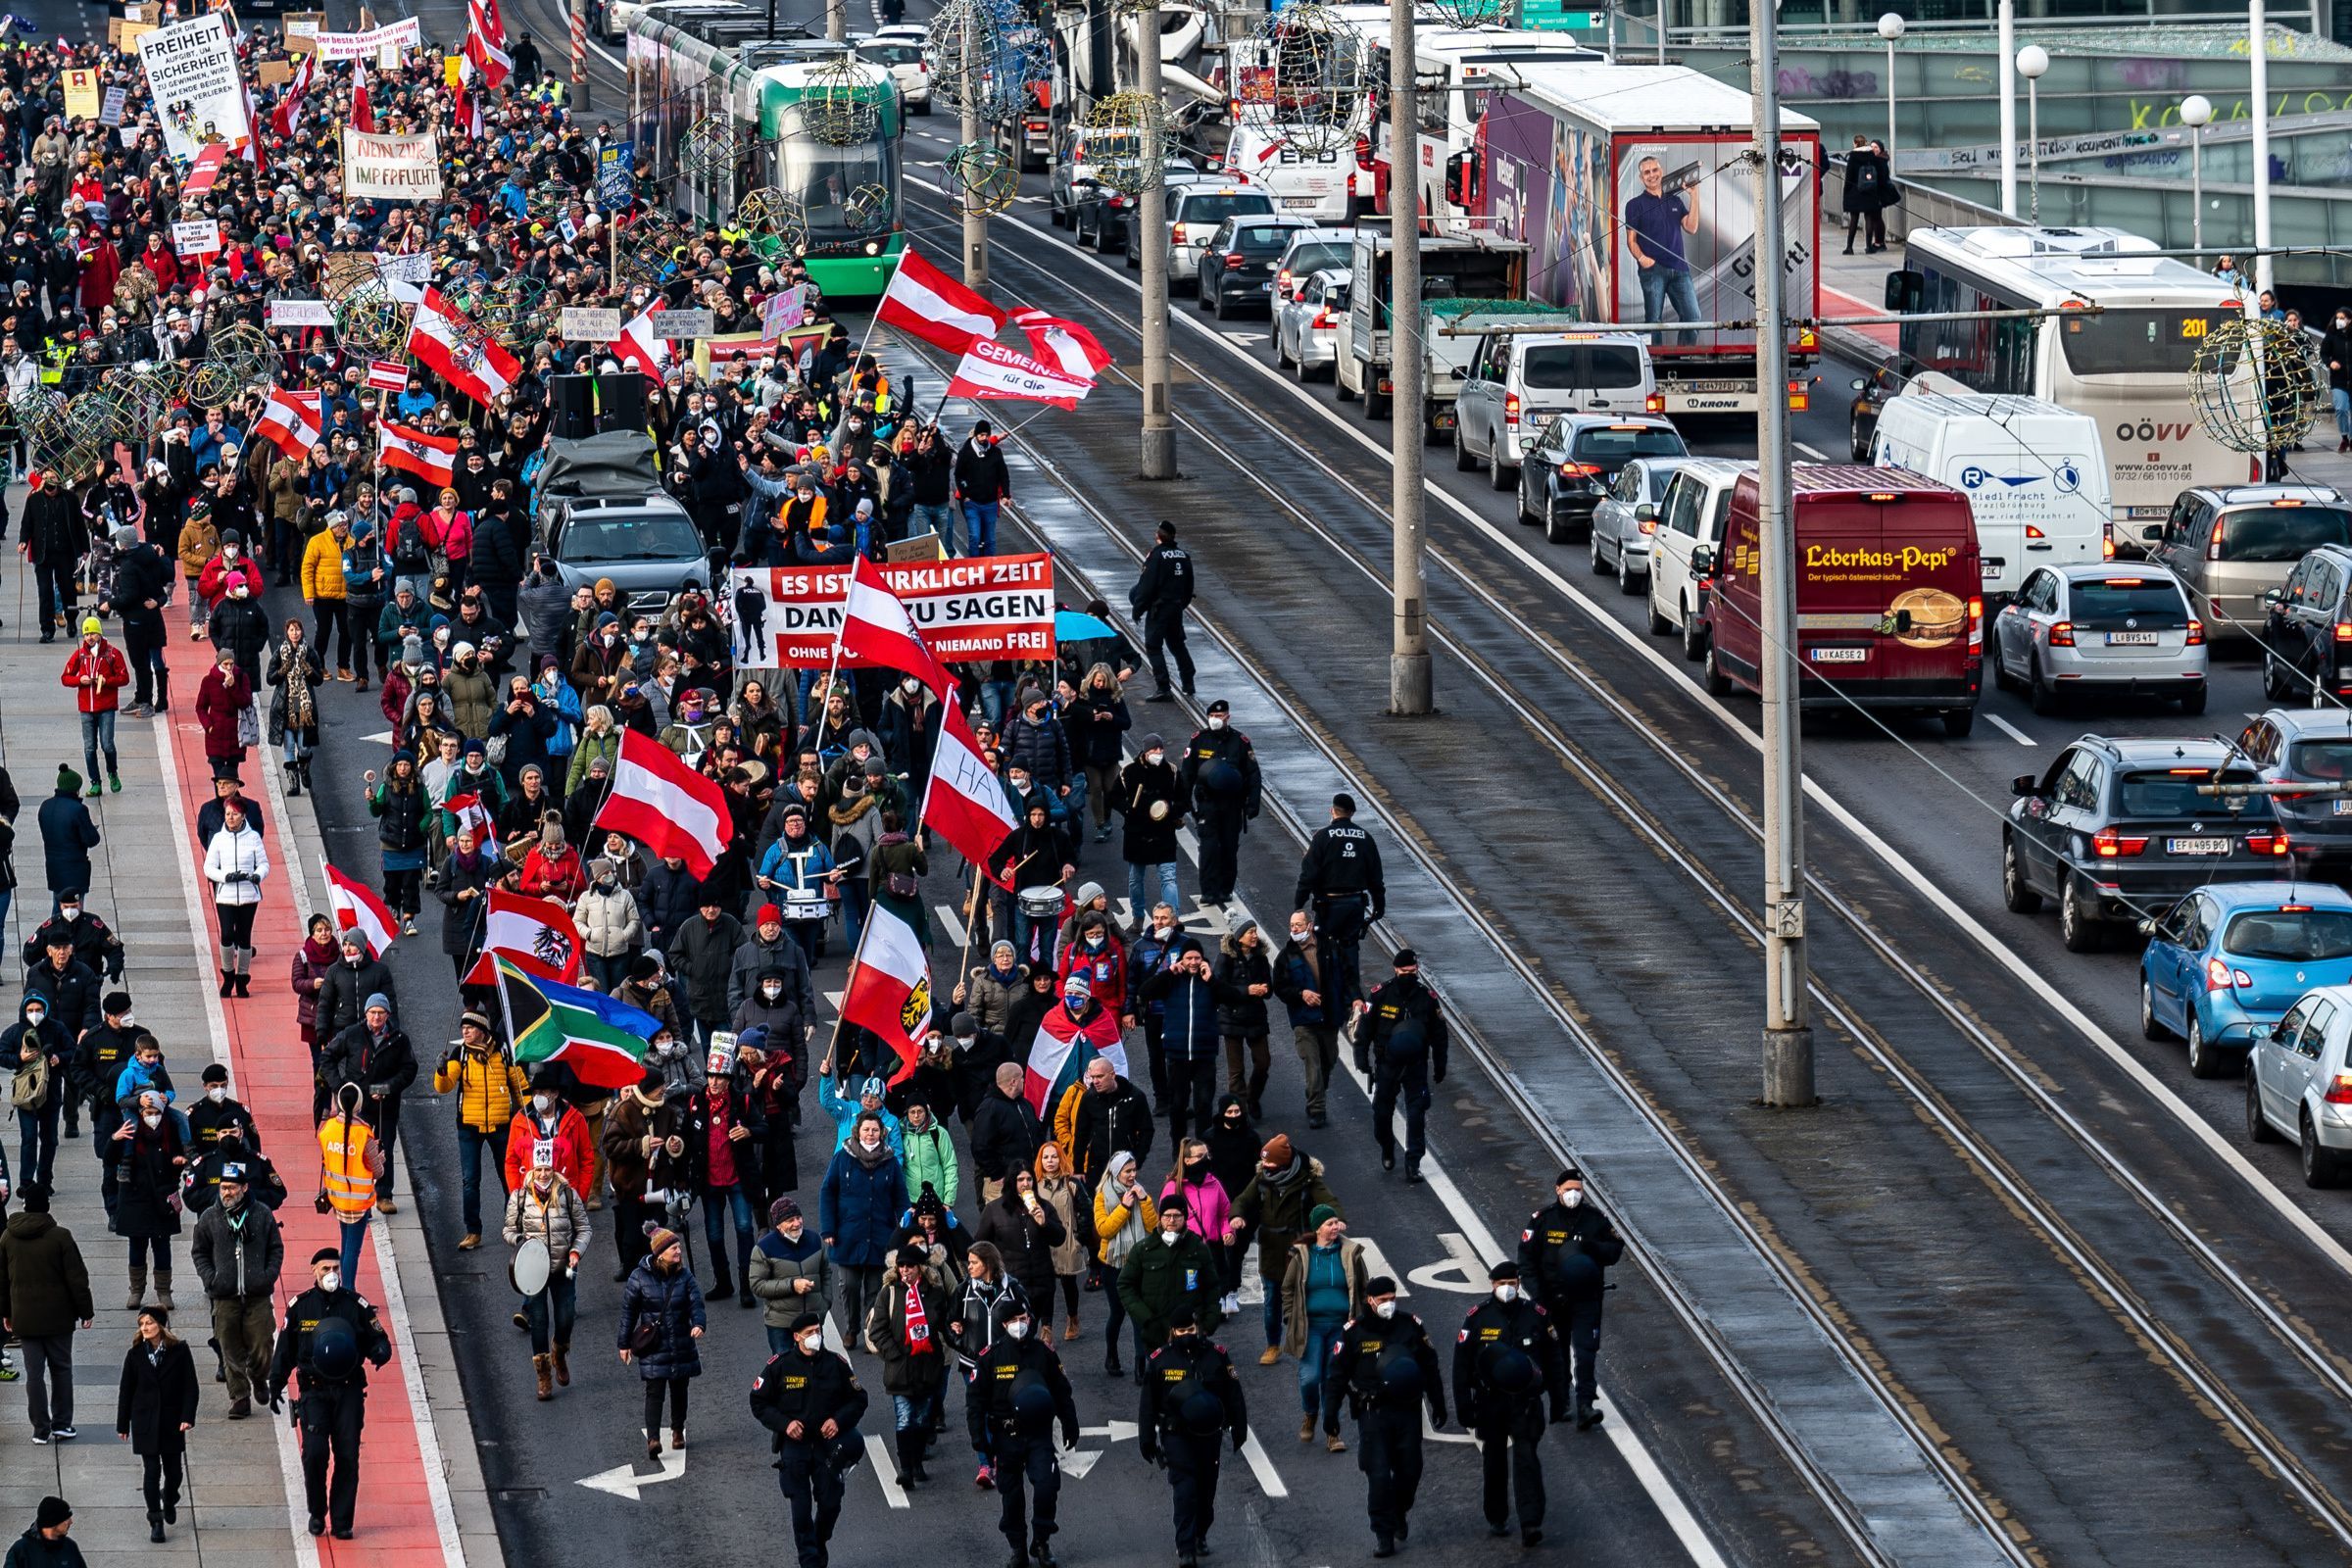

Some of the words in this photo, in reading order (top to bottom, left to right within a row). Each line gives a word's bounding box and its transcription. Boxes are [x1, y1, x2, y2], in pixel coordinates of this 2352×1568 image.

[184, 24, 197, 32] DIE
[318, 35, 329, 44] Der
[355, 33, 382, 44] Sklave
[383, 28, 394, 38] ist
[145, 26, 220, 60] FREIHEIT
[152, 51, 228, 82] SICHERHEIT
[157, 82, 168, 91] ZU
[211, 66, 230, 76] WIRD
[167, 89, 177, 99] AM
[178, 84, 198, 95] ENDE
[200, 76, 226, 89] BEIDES
[359, 139, 394, 158] NEIN
[357, 167, 437, 185] IMPFPFLICHT
[406, 255, 429, 267] ZUM
[2182, 319, 2207, 338] 201
[1003, 374, 1020, 385] für
[1024, 379, 1046, 390] die
[2115, 463, 2192, 471] www.ooevv.at
[1972, 492, 2002, 501] Riedl
[2007, 492, 2045, 501] Fracht
[782, 575, 808, 596] ES
[816, 574, 851, 594] IST
[880, 566, 986, 591] IRKLICH
[994, 562, 1045, 582] ZEIT
[785, 606, 844, 628] DAN
[947, 595, 1046, 620] SAGEN
[789, 646, 828, 659] OHNE
[935, 638, 1003, 652] NIEMAND
[1007, 631, 1047, 650] FREI
[1329, 828, 1365, 839] POLIZEI
[2176, 841, 2187, 850] EF
[2195, 841, 2211, 850] 495
[2213, 841, 2226, 850] BG
